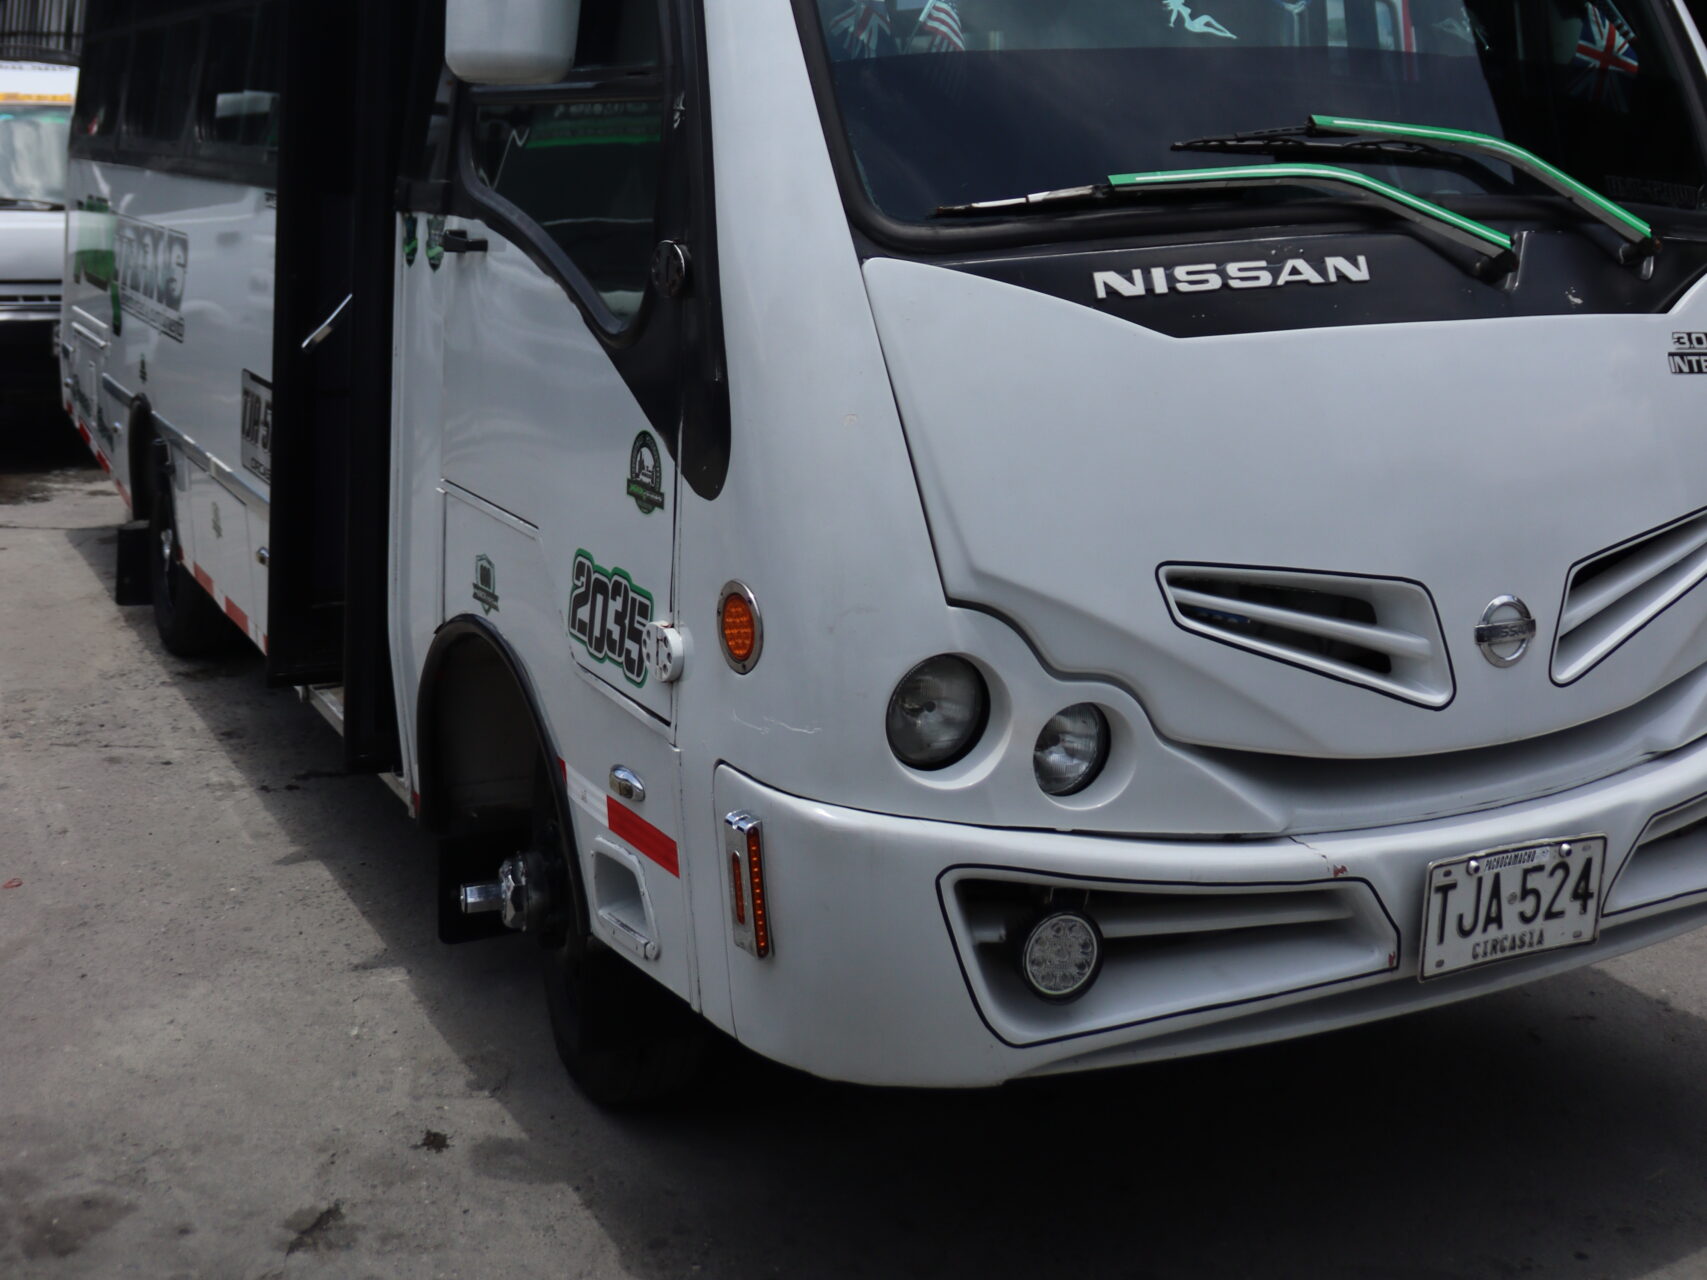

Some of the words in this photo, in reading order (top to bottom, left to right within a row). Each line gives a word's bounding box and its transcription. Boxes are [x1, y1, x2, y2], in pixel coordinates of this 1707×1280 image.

[1092, 255, 1370, 300] NISSAN
[1669, 354, 1707, 373] INTE
[569, 555, 651, 682] 2035
[1434, 871, 1503, 946] TJA
[1518, 856, 1595, 925] 524
[1472, 928, 1545, 961] CIRCASIA
